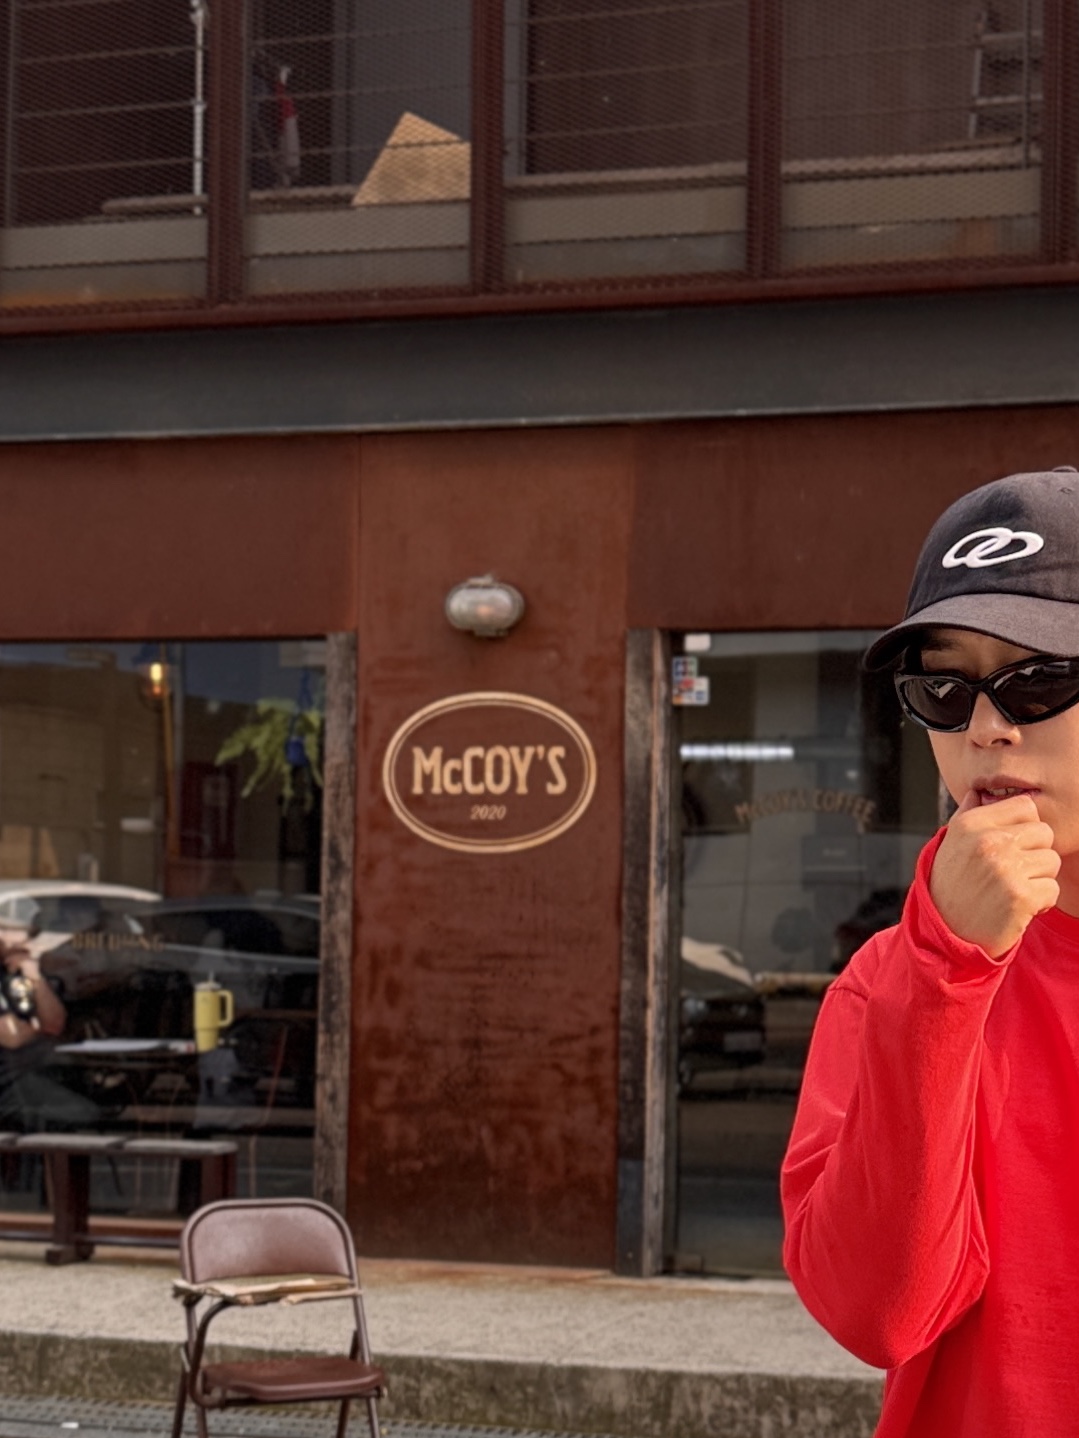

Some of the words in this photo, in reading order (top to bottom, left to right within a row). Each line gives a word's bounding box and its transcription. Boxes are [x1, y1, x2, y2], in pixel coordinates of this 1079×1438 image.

[411, 744, 568, 795] McCOY'S
[469, 804, 508, 821] 2020
[811, 788, 877, 824] COFFEE
